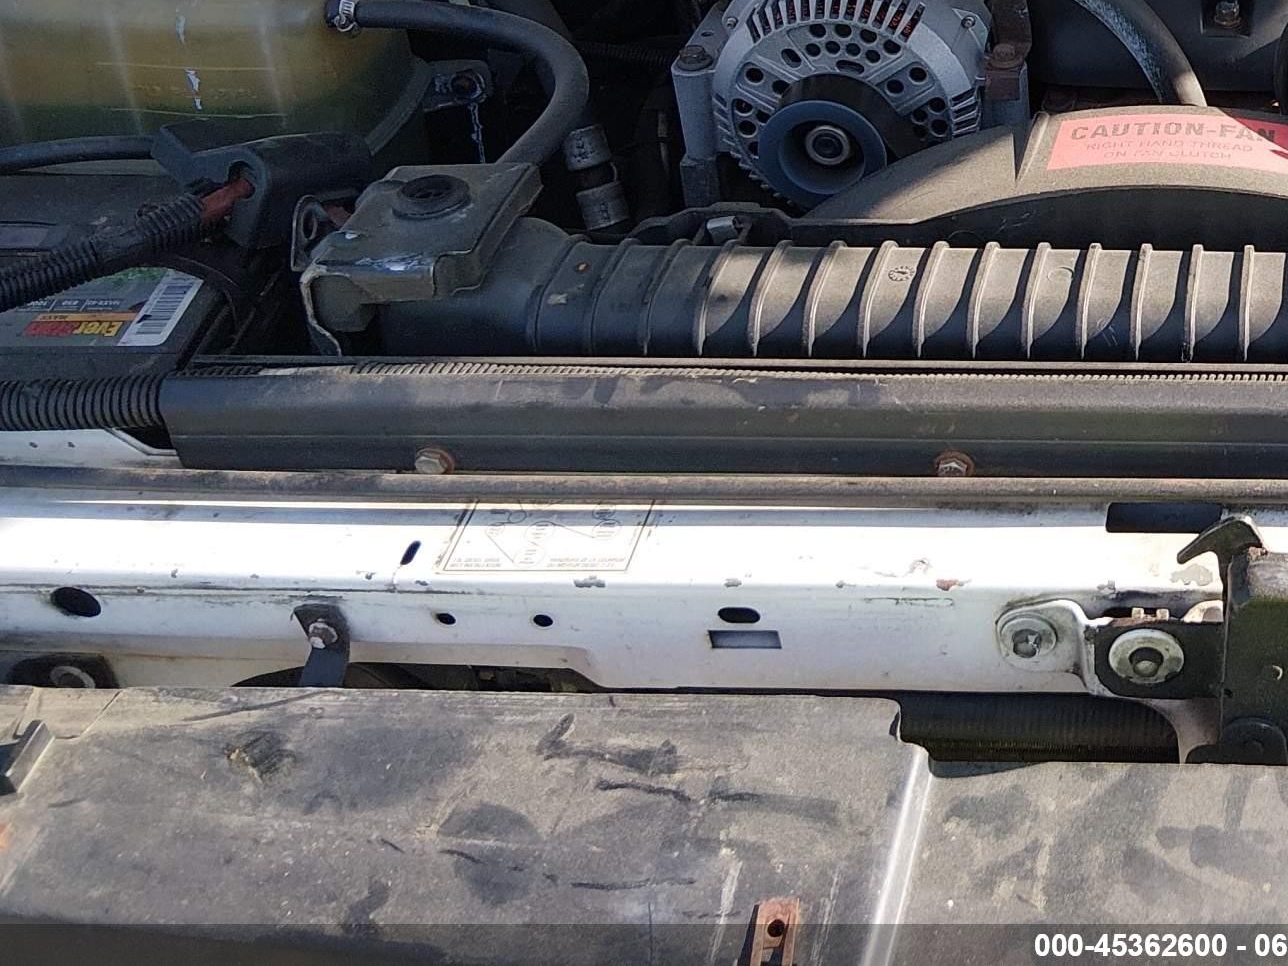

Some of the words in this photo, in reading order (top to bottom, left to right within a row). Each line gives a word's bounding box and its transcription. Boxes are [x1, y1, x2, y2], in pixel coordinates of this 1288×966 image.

[1070, 121, 1276, 143] CAUTION-FAN
[1086, 139, 1136, 151] RIGHT
[1138, 139, 1186, 149] HAND
[1190, 140, 1254, 153] THREAD
[1103, 150, 1127, 159] ON
[1168, 150, 1232, 160] CLUTCH
